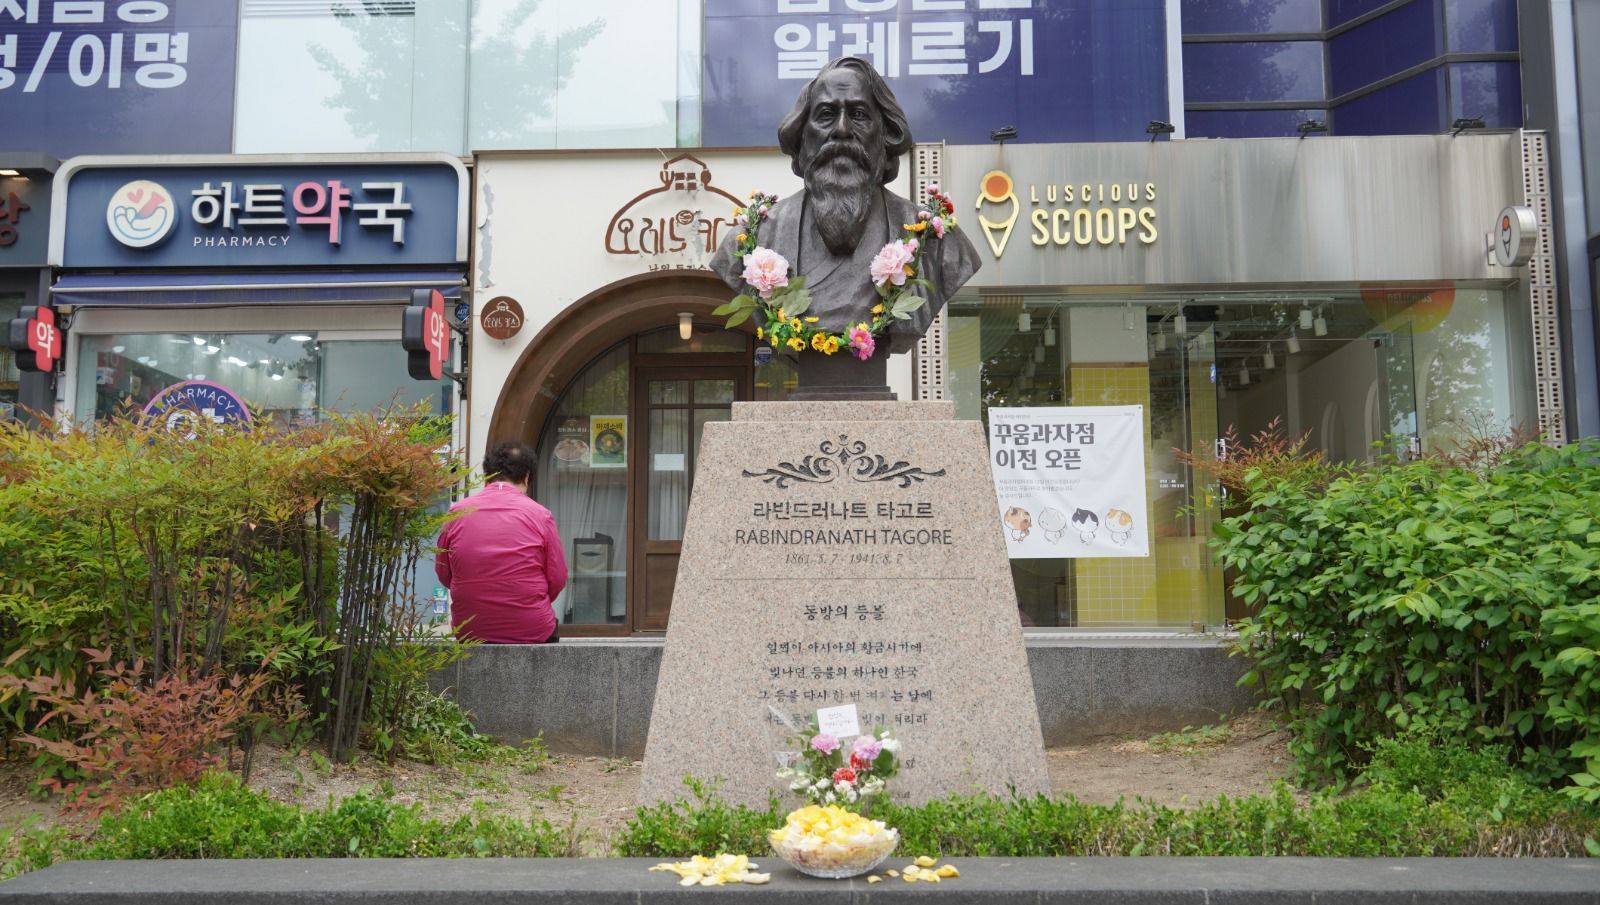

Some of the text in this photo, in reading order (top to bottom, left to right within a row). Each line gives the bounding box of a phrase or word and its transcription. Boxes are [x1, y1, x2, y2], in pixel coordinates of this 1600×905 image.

[773, 18, 1034, 79] 알레르기
[1030, 182, 1156, 203] LUSCIOUS
[192, 180, 413, 245] 하트약국
[1031, 207, 1158, 246] SCOOPS
[193, 236, 290, 247] PHARMACY
[36, 322, 54, 359] 약
[431, 311, 444, 361] 약
[994, 422, 1095, 446] 꾸움과자점
[995, 448, 1082, 471] 이전 오픈
[753, 501, 935, 520] 라빈드러나트 타고르
[735, 529, 953, 545] RABINDRANATH TAGORE
[803, 604, 885, 621] 동방의 등불
[808, 642, 856, 654] 아시아의
[811, 666, 847, 679] 등불의
[852, 666, 888, 678] 하나인
[894, 666, 919, 679] 한국
[758, 690, 770, 700] 그
[775, 689, 799, 703] 등불
[803, 689, 827, 701] 다시
[909, 689, 932, 703] 날에
